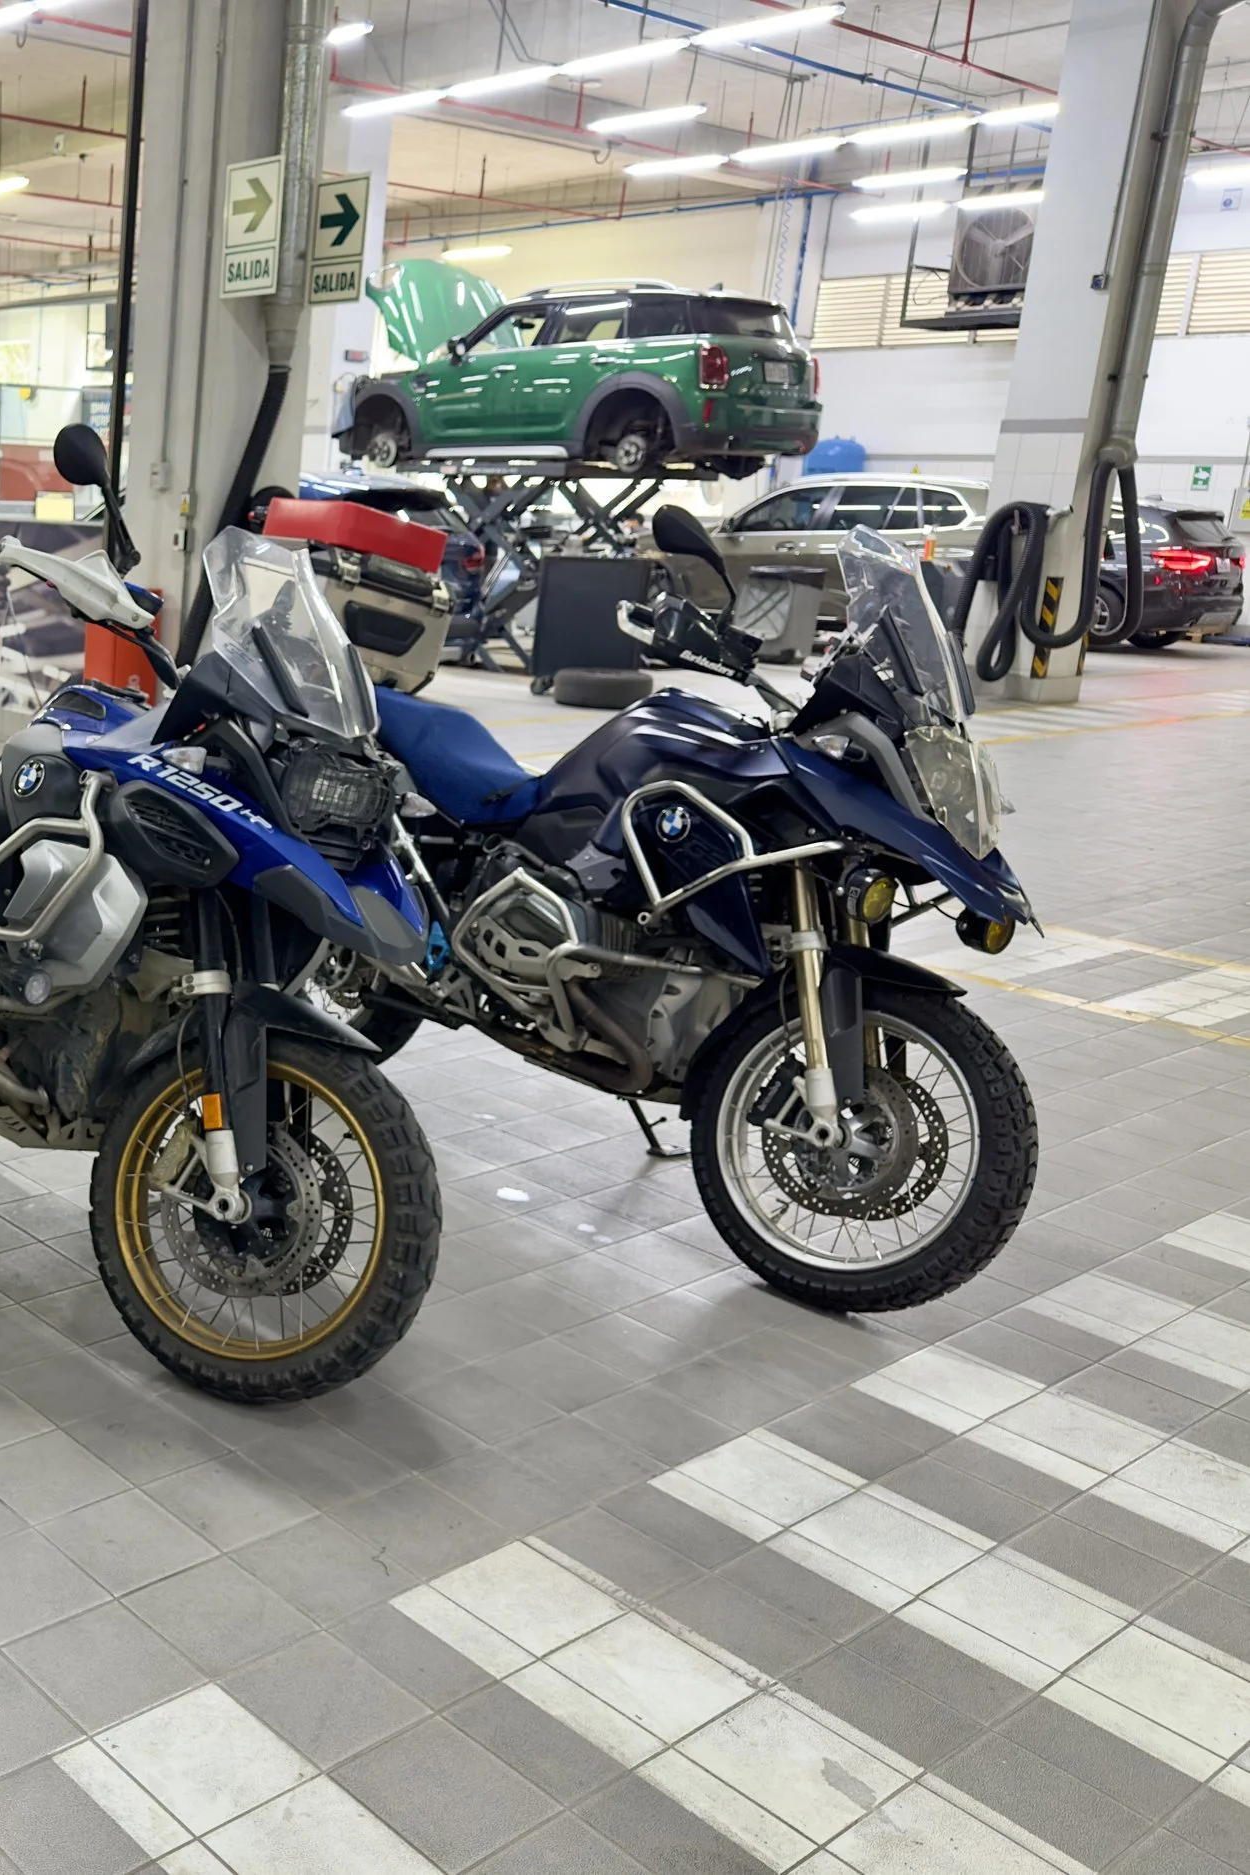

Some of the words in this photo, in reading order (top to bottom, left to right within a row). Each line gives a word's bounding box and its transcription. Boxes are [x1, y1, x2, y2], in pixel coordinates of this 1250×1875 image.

[227, 258, 270, 283] SALIDA
[313, 272, 356, 294] SALIDA
[127, 753, 162, 772] R
[156, 764, 244, 813] 1250
[240, 808, 274, 831] HP
